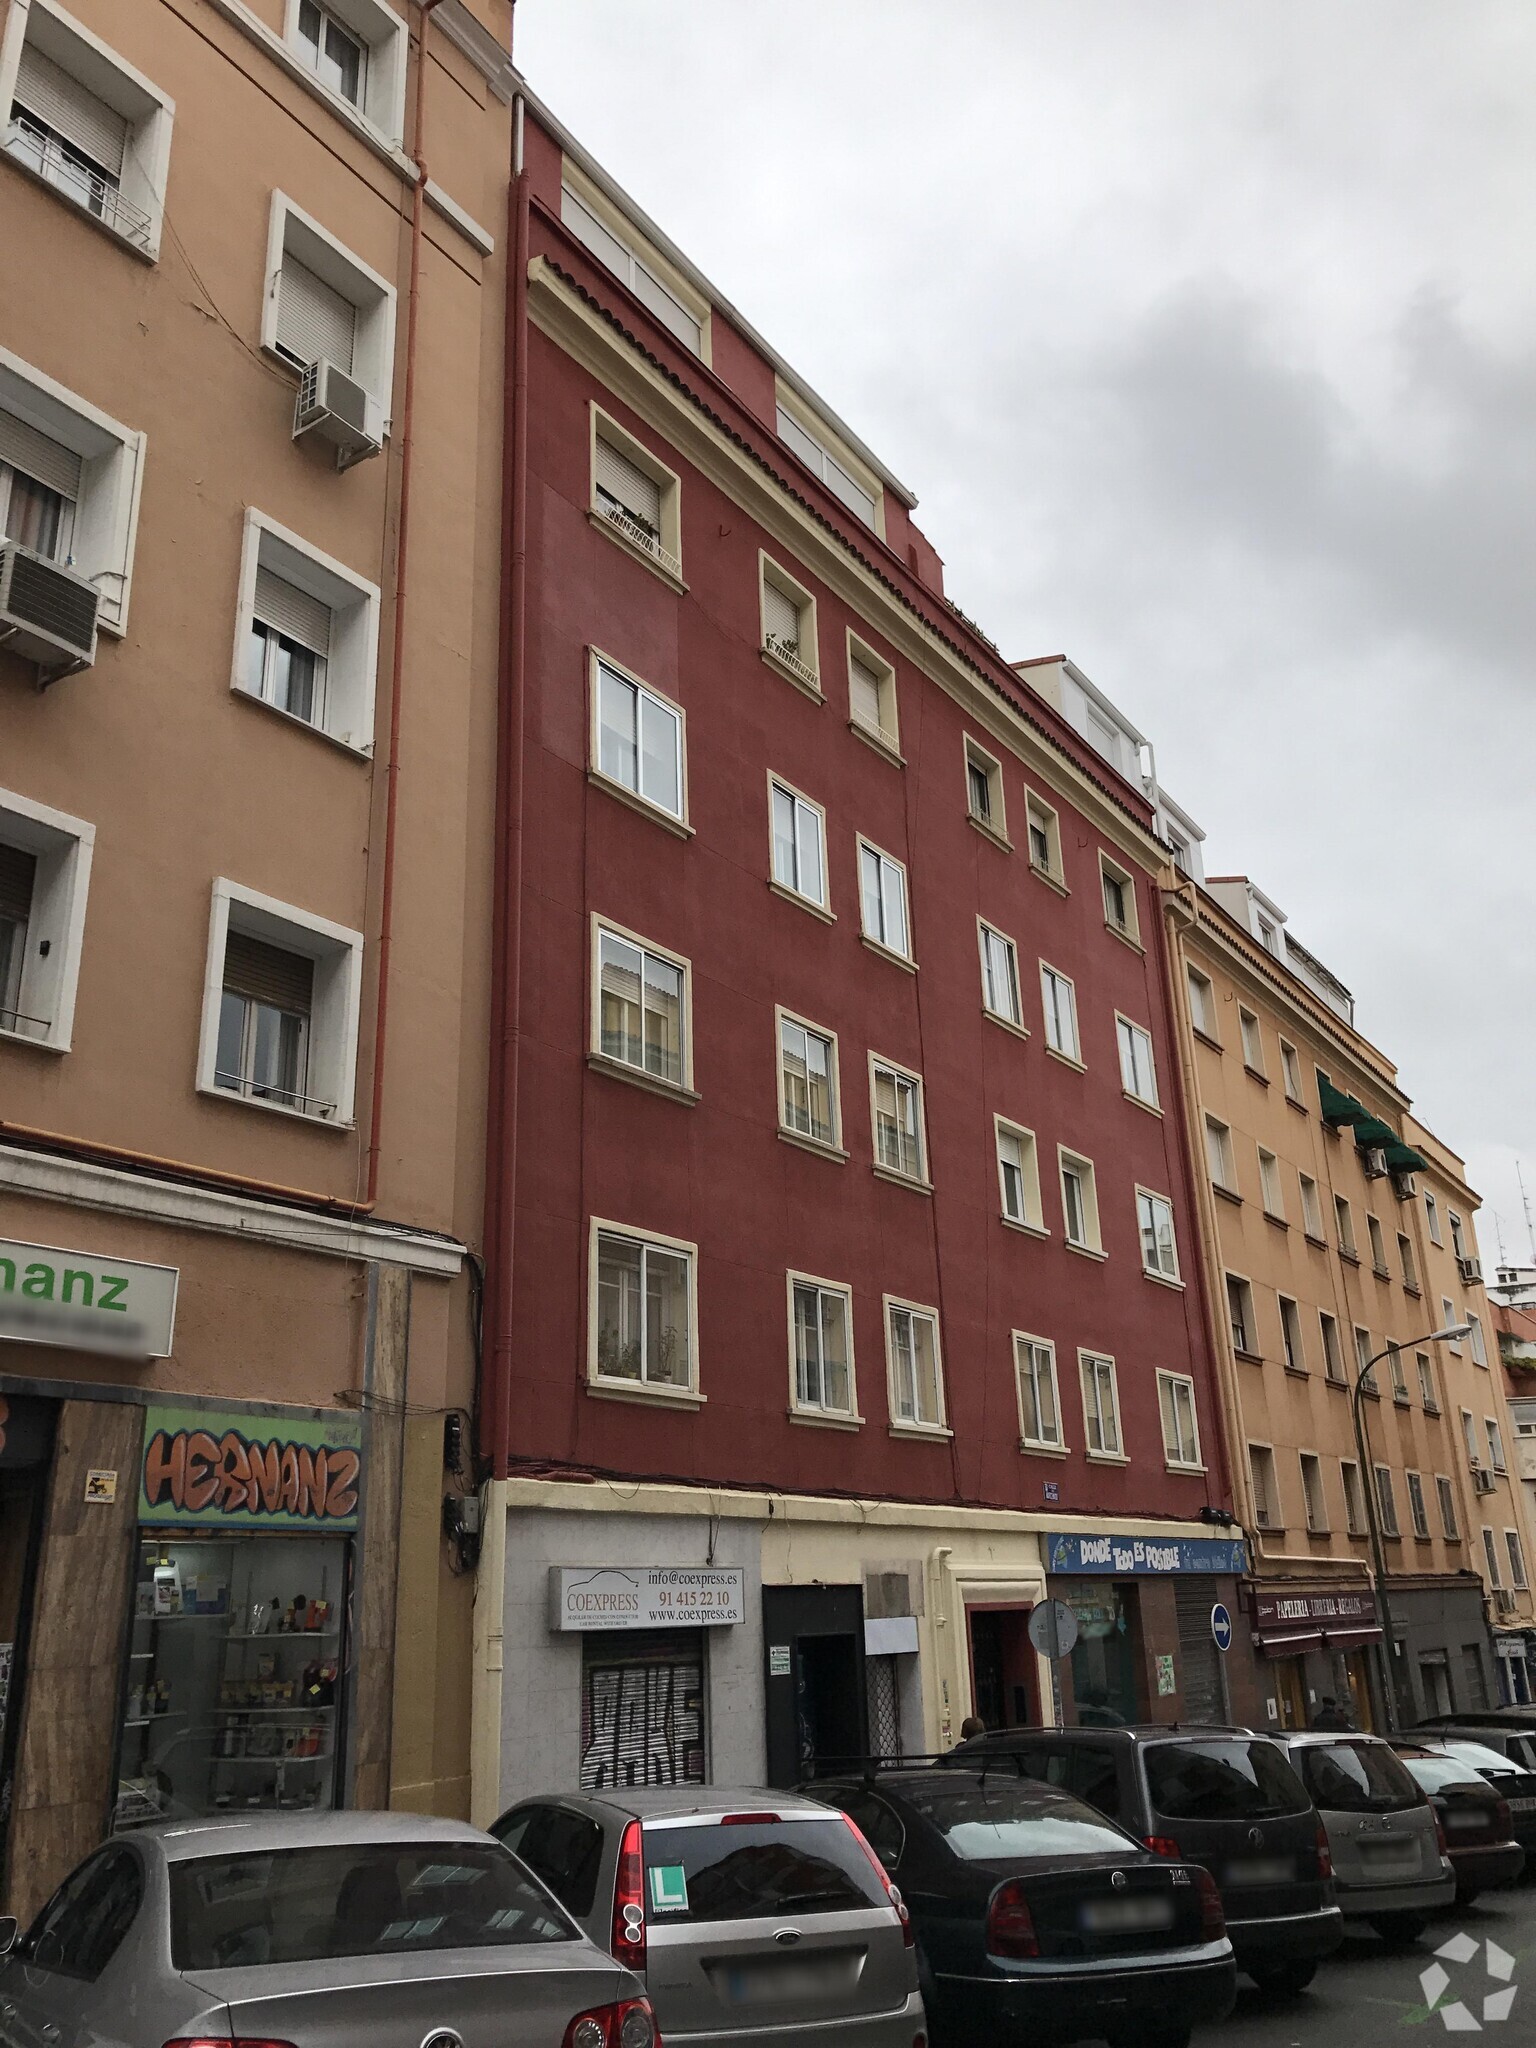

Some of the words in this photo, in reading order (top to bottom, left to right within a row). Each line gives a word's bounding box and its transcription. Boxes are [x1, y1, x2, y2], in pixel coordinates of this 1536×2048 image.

[145, 1430, 360, 1519] HERNANZ
[1080, 1538, 1112, 1565] DONDE
[1134, 1542, 1145, 1562] ES
[1145, 1545, 1180, 1571] POSIBLE
[648, 1570, 737, 1588] info@coexpress.es
[567, 1593, 639, 1611] COEXPRESS
[659, 1591, 672, 1606] 91
[676, 1591, 697, 1606] 415
[700, 1591, 713, 1605] 22
[717, 1591, 730, 1605] 10
[1276, 1600, 1310, 1619] PAPELERIA
[1311, 1599, 1336, 1616] LIBRERIA
[1338, 1597, 1361, 1614] REGALOS
[648, 1609, 738, 1623] www.coexpress.es
[654, 1867, 683, 1904] L
